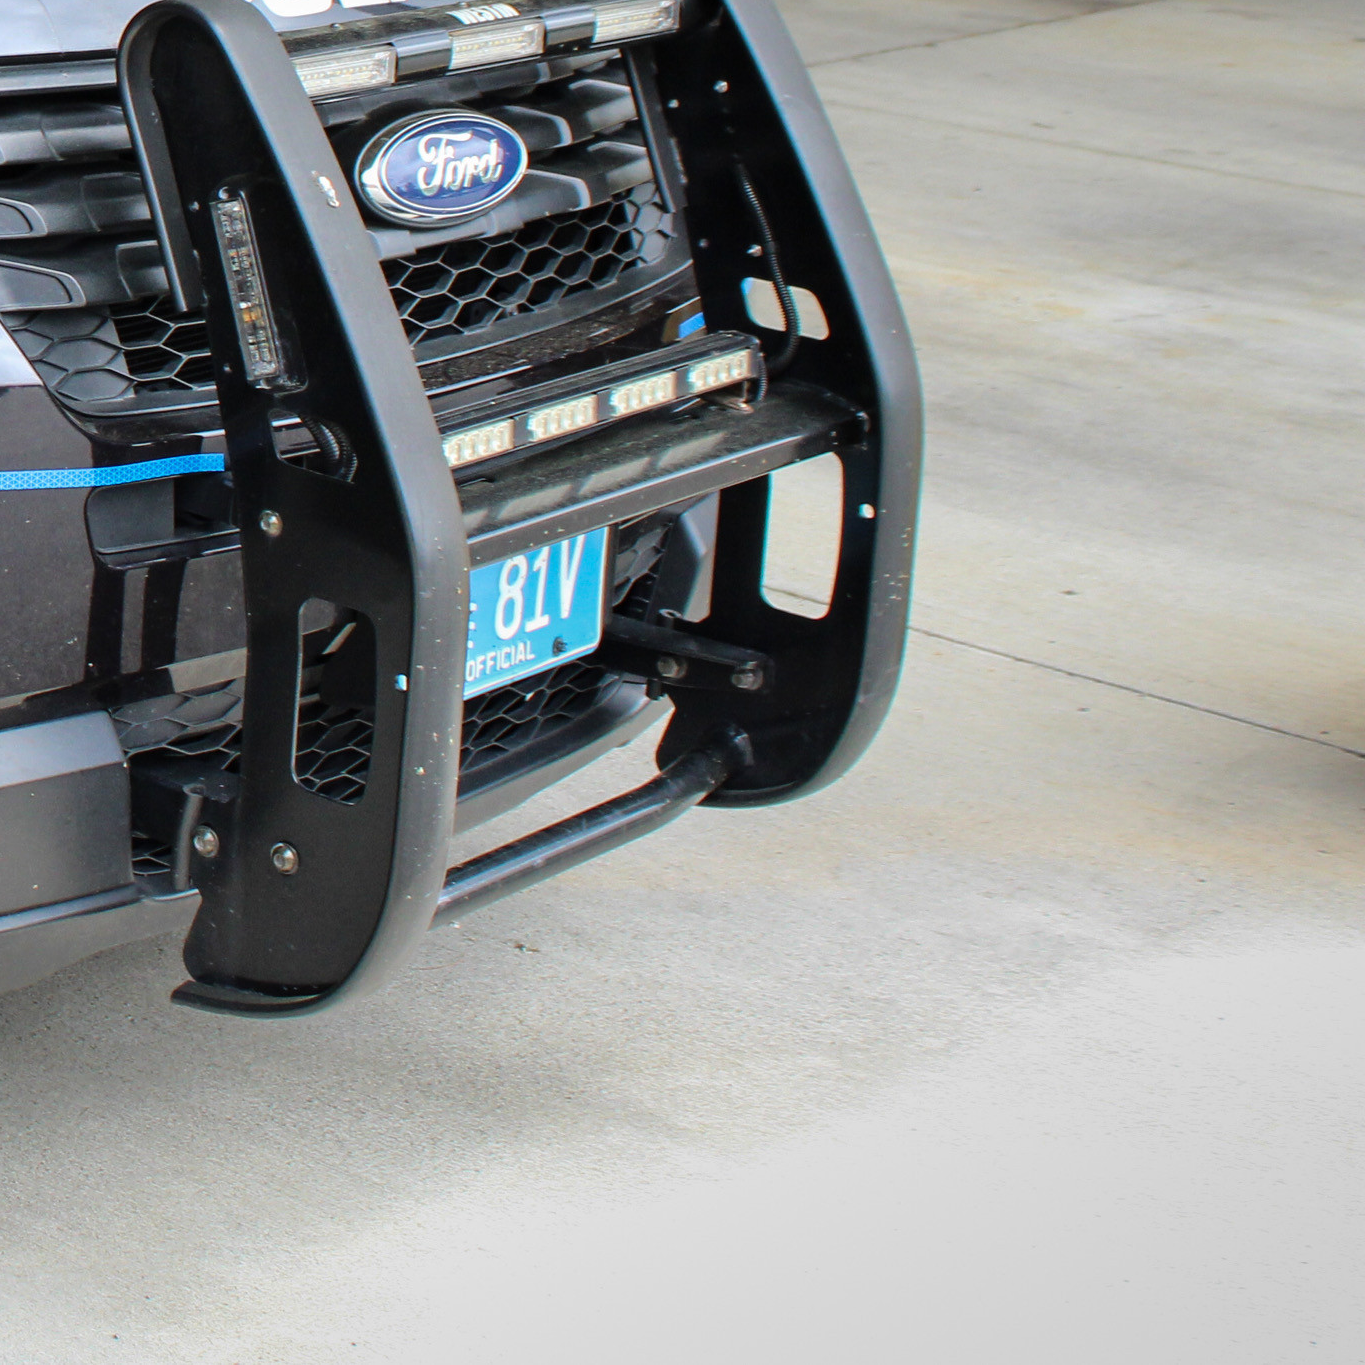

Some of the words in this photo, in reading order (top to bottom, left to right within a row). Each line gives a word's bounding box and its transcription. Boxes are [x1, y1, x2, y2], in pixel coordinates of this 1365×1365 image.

[445, 2, 522, 25] WESTIN
[417, 130, 504, 197] Ford
[494, 533, 587, 641] 81V
[465, 639, 536, 682] OFFICIAL
